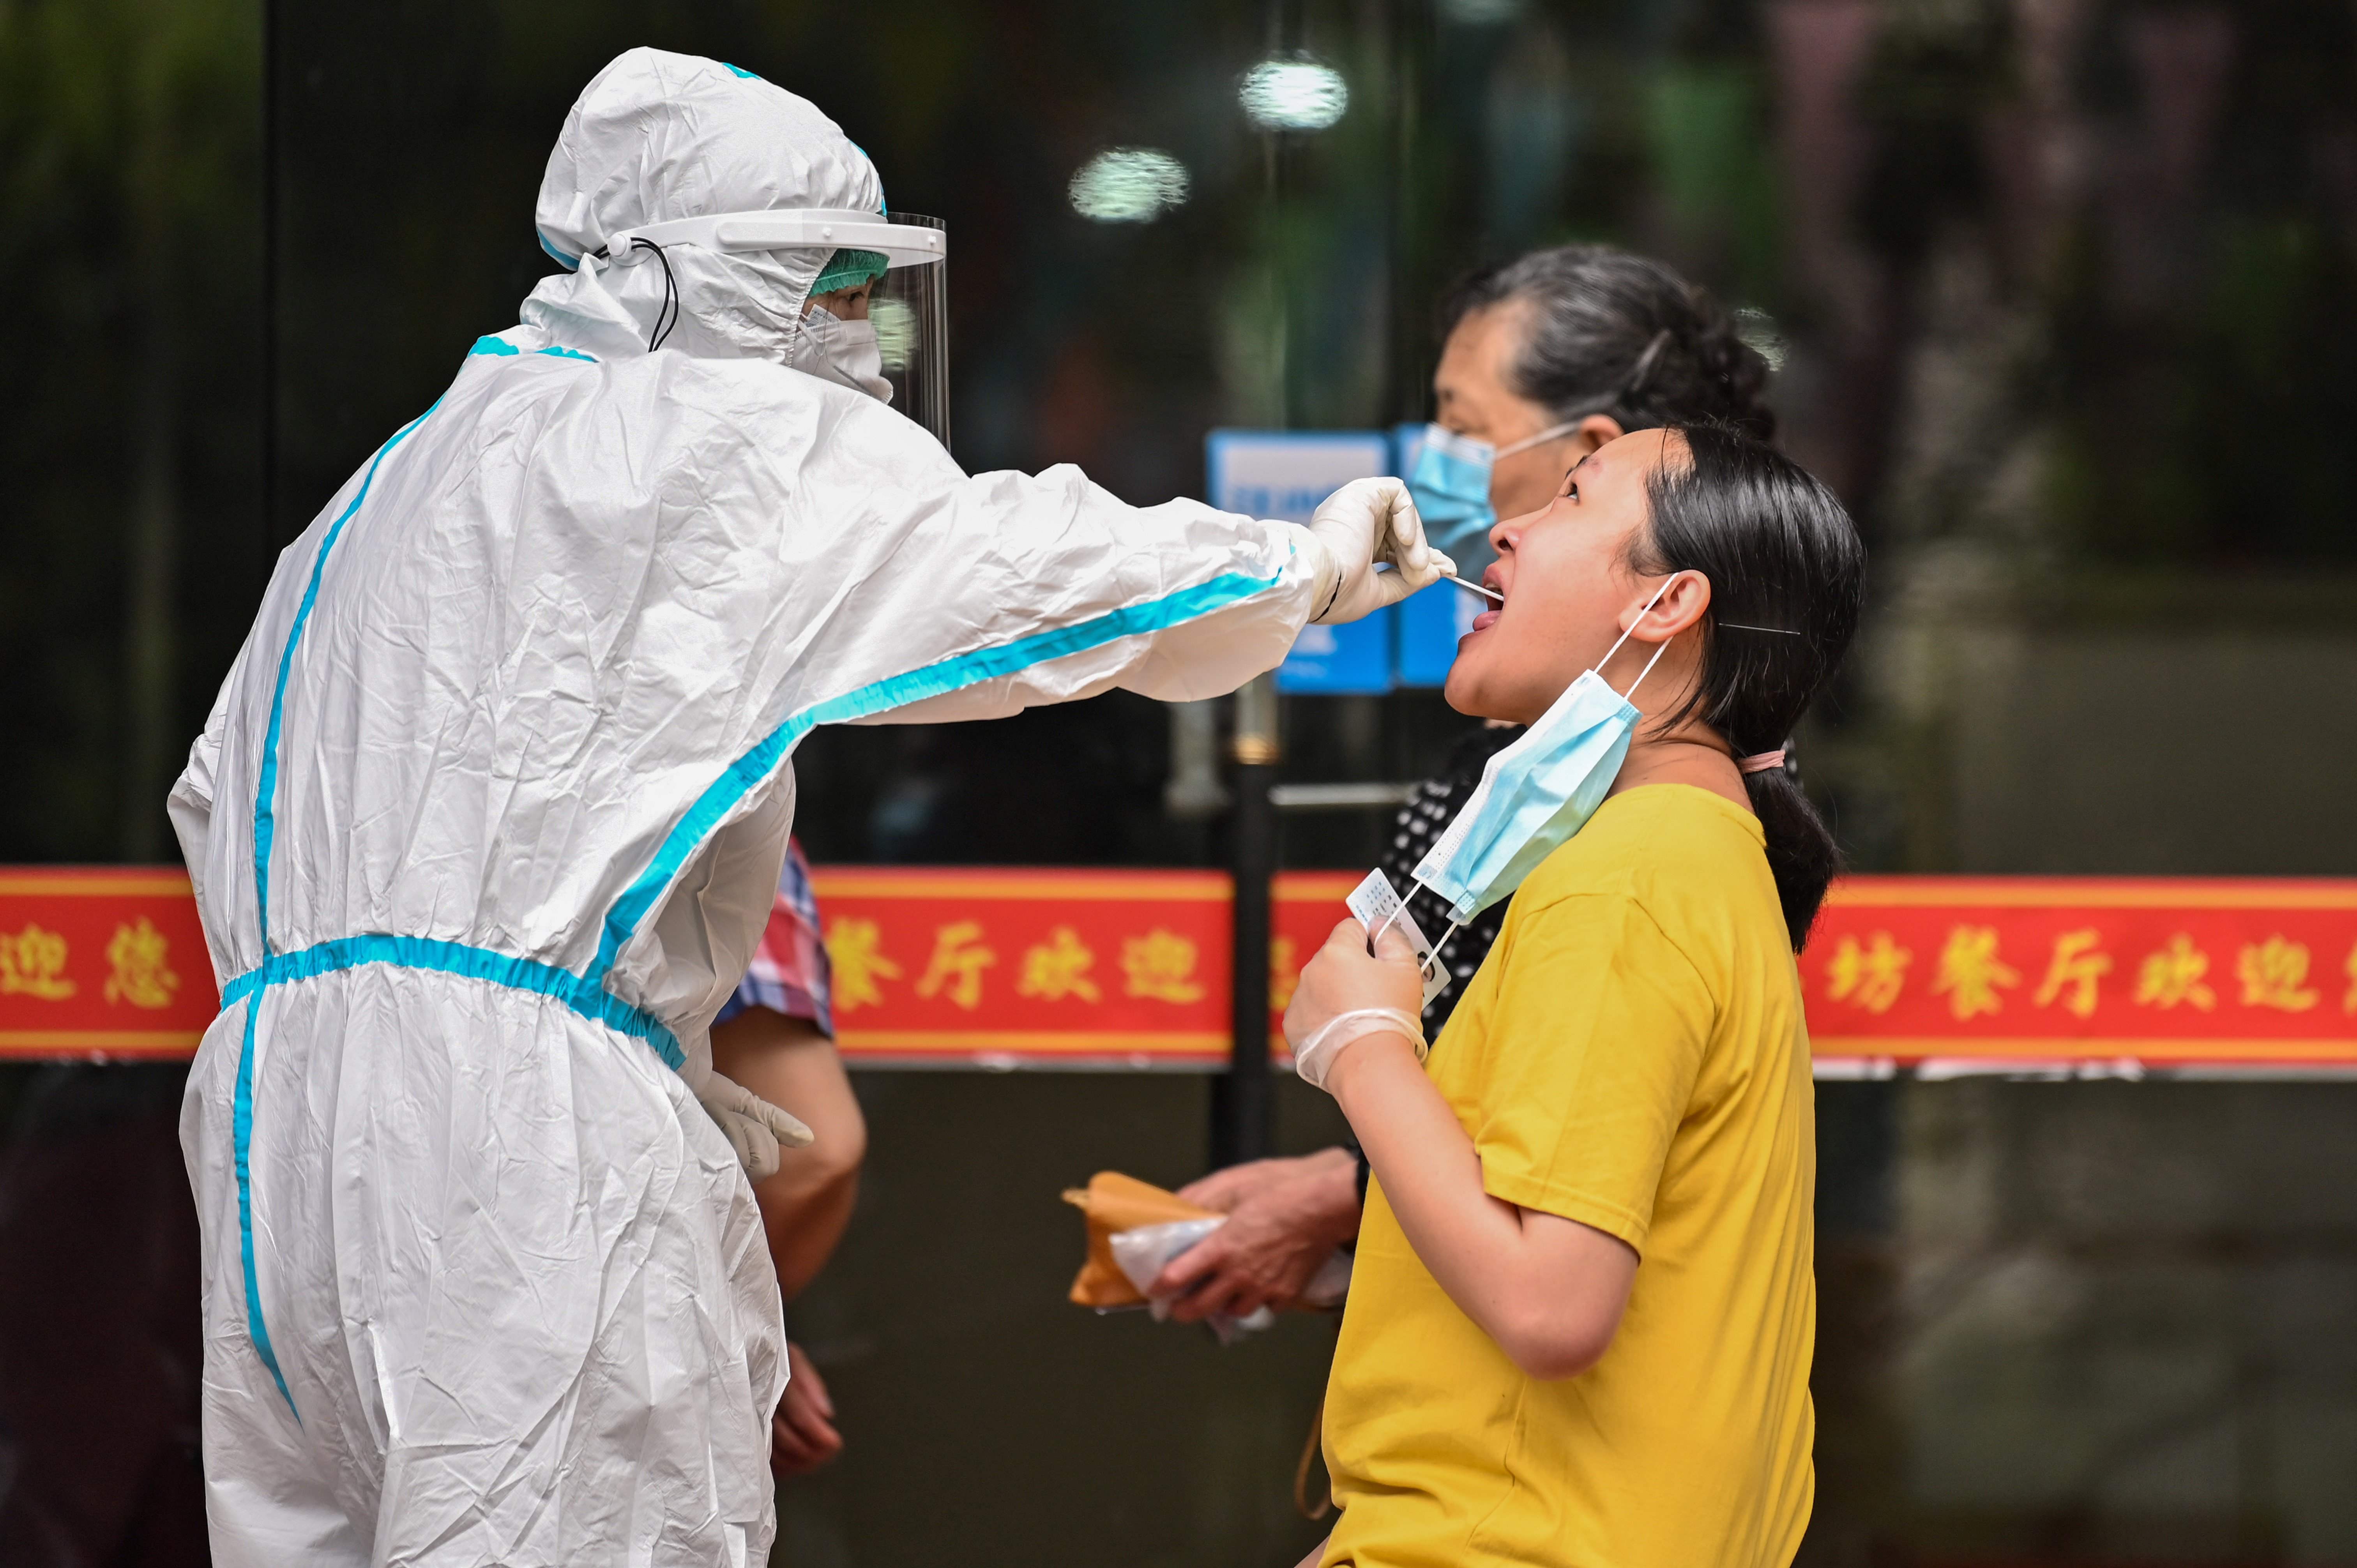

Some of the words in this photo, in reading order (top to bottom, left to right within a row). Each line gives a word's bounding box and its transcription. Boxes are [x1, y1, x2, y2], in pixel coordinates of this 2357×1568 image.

[1825, 925, 2357, 1018] 坊餐厅欢迎
